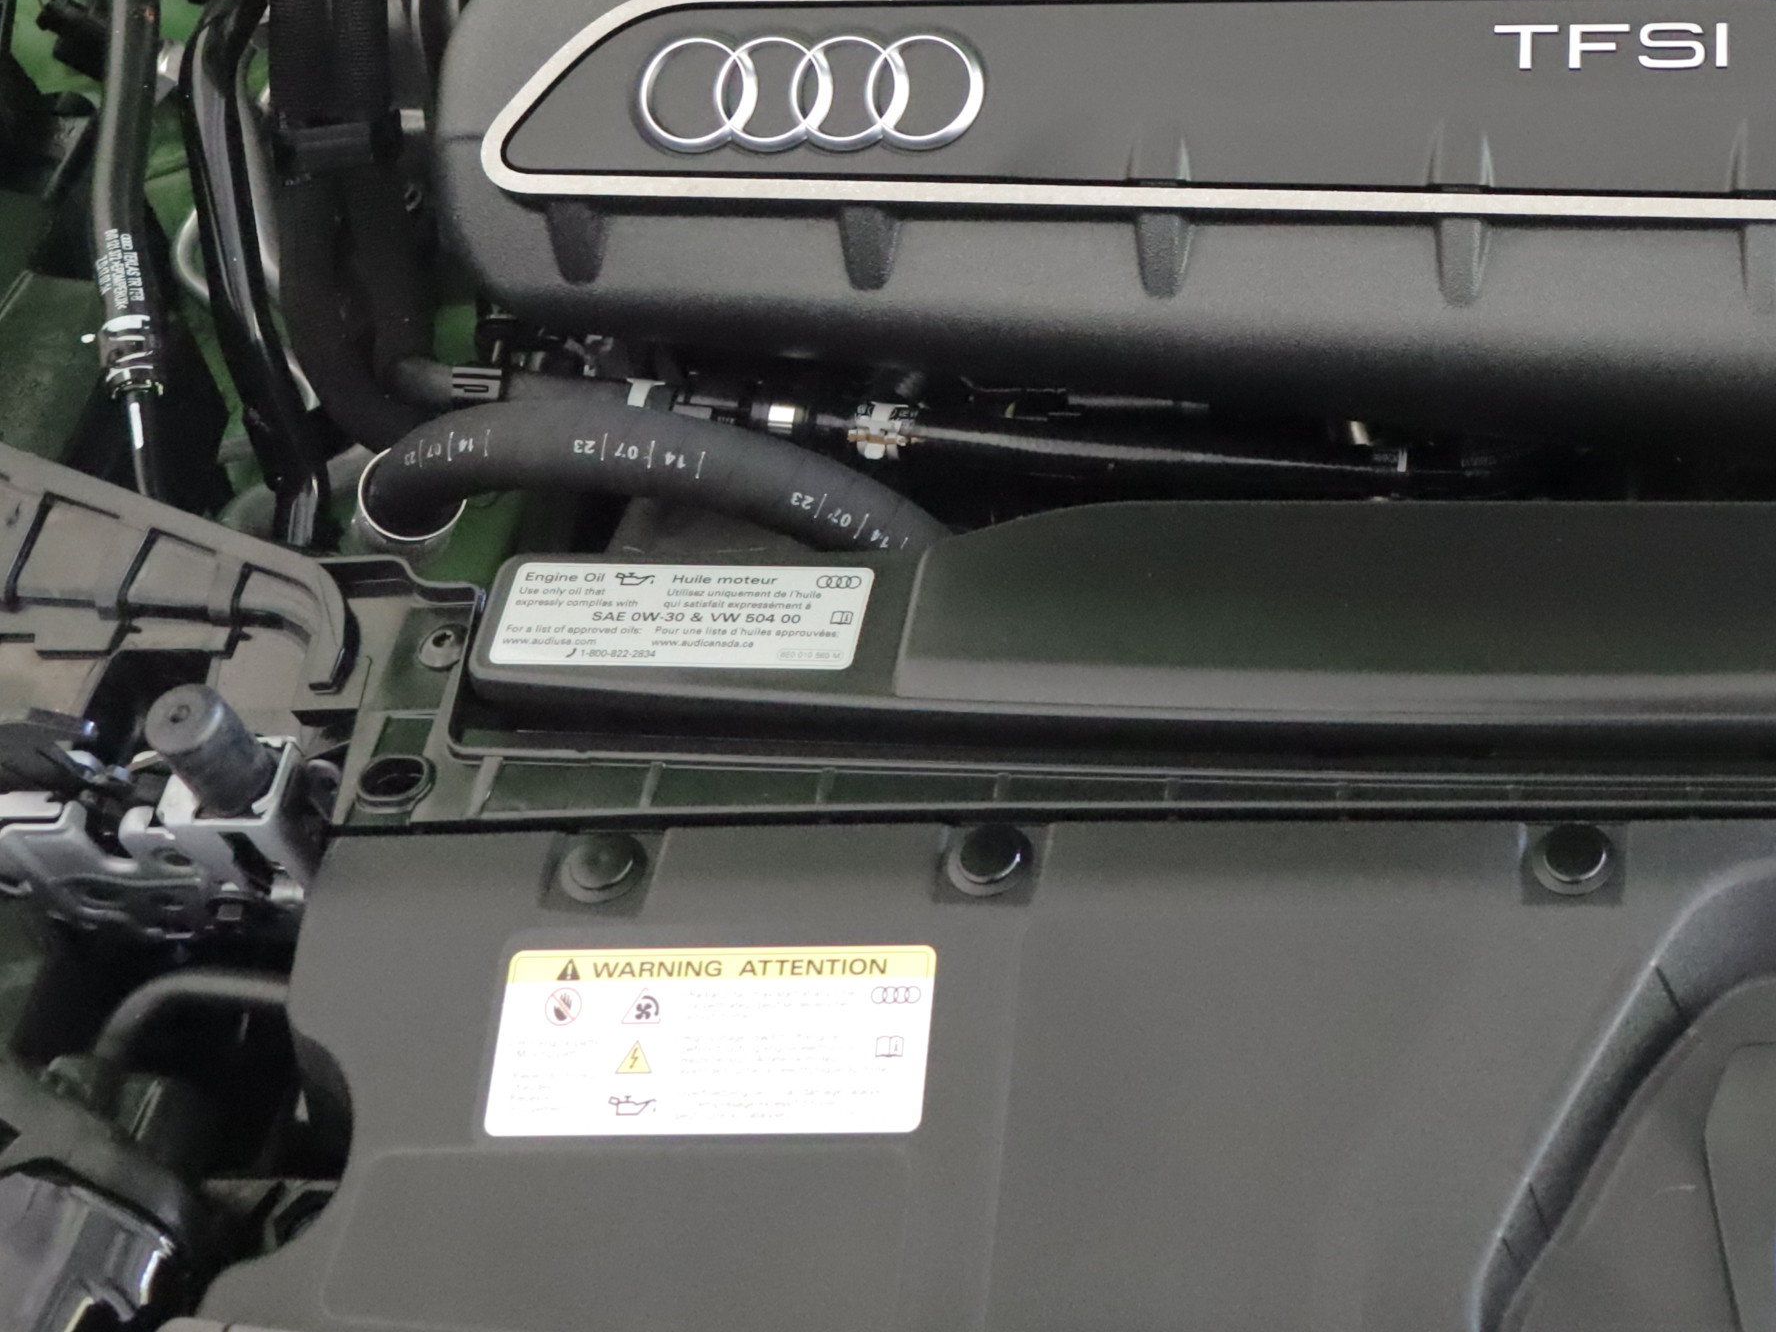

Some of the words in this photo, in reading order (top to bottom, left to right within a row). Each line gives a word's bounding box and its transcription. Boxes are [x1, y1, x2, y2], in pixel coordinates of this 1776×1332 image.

[1494, 22, 1729, 70] TFSI
[573, 439, 596, 454] 23
[614, 442, 639, 460] 07
[664, 451, 686, 469] 14
[790, 492, 815, 510] 23
[525, 572, 579, 584] Engine
[584, 572, 606, 582] Oil
[672, 574, 712, 585] Huile
[717, 576, 779, 585] moteur
[519, 587, 538, 595] Use
[543, 587, 567, 597] only
[568, 587, 582, 595] oil
[585, 587, 606, 596] that
[667, 588, 705, 597] Utilisez
[707, 589, 771, 599] uniquement
[774, 590, 787, 599] de
[790, 591, 822, 599] l'huile
[515, 598, 564, 608] expressly
[566, 599, 613, 608] complies
[616, 600, 638, 608] with
[664, 600, 680, 610] qui
[683, 600, 724, 609] satisfait
[727, 600, 803, 610] expressément
[592, 611, 626, 622] SAE
[631, 611, 686, 623] 0W-30
[691, 612, 703, 623] &
[710, 613, 740, 623] VW
[745, 613, 775, 623] 504
[781, 614, 801, 624] 00
[506, 624, 524, 633] For
[535, 625, 551, 634] list
[554, 625, 565, 634] of
[567, 626, 617, 636] approved
[620, 626, 643, 635] oils:
[655, 626, 679, 636] Pour
[683, 628, 702, 636] une
[705, 627, 727, 636] liste
[731, 627, 772, 637] d'huiles
[502, 636, 598, 646] www.audiusa.com
[651, 638, 754, 648] www.audicanada.ca
[580, 648, 656, 658] 1-800-822-2834
[593, 960, 723, 978] WARNING
[739, 958, 888, 977] ATTENTION
